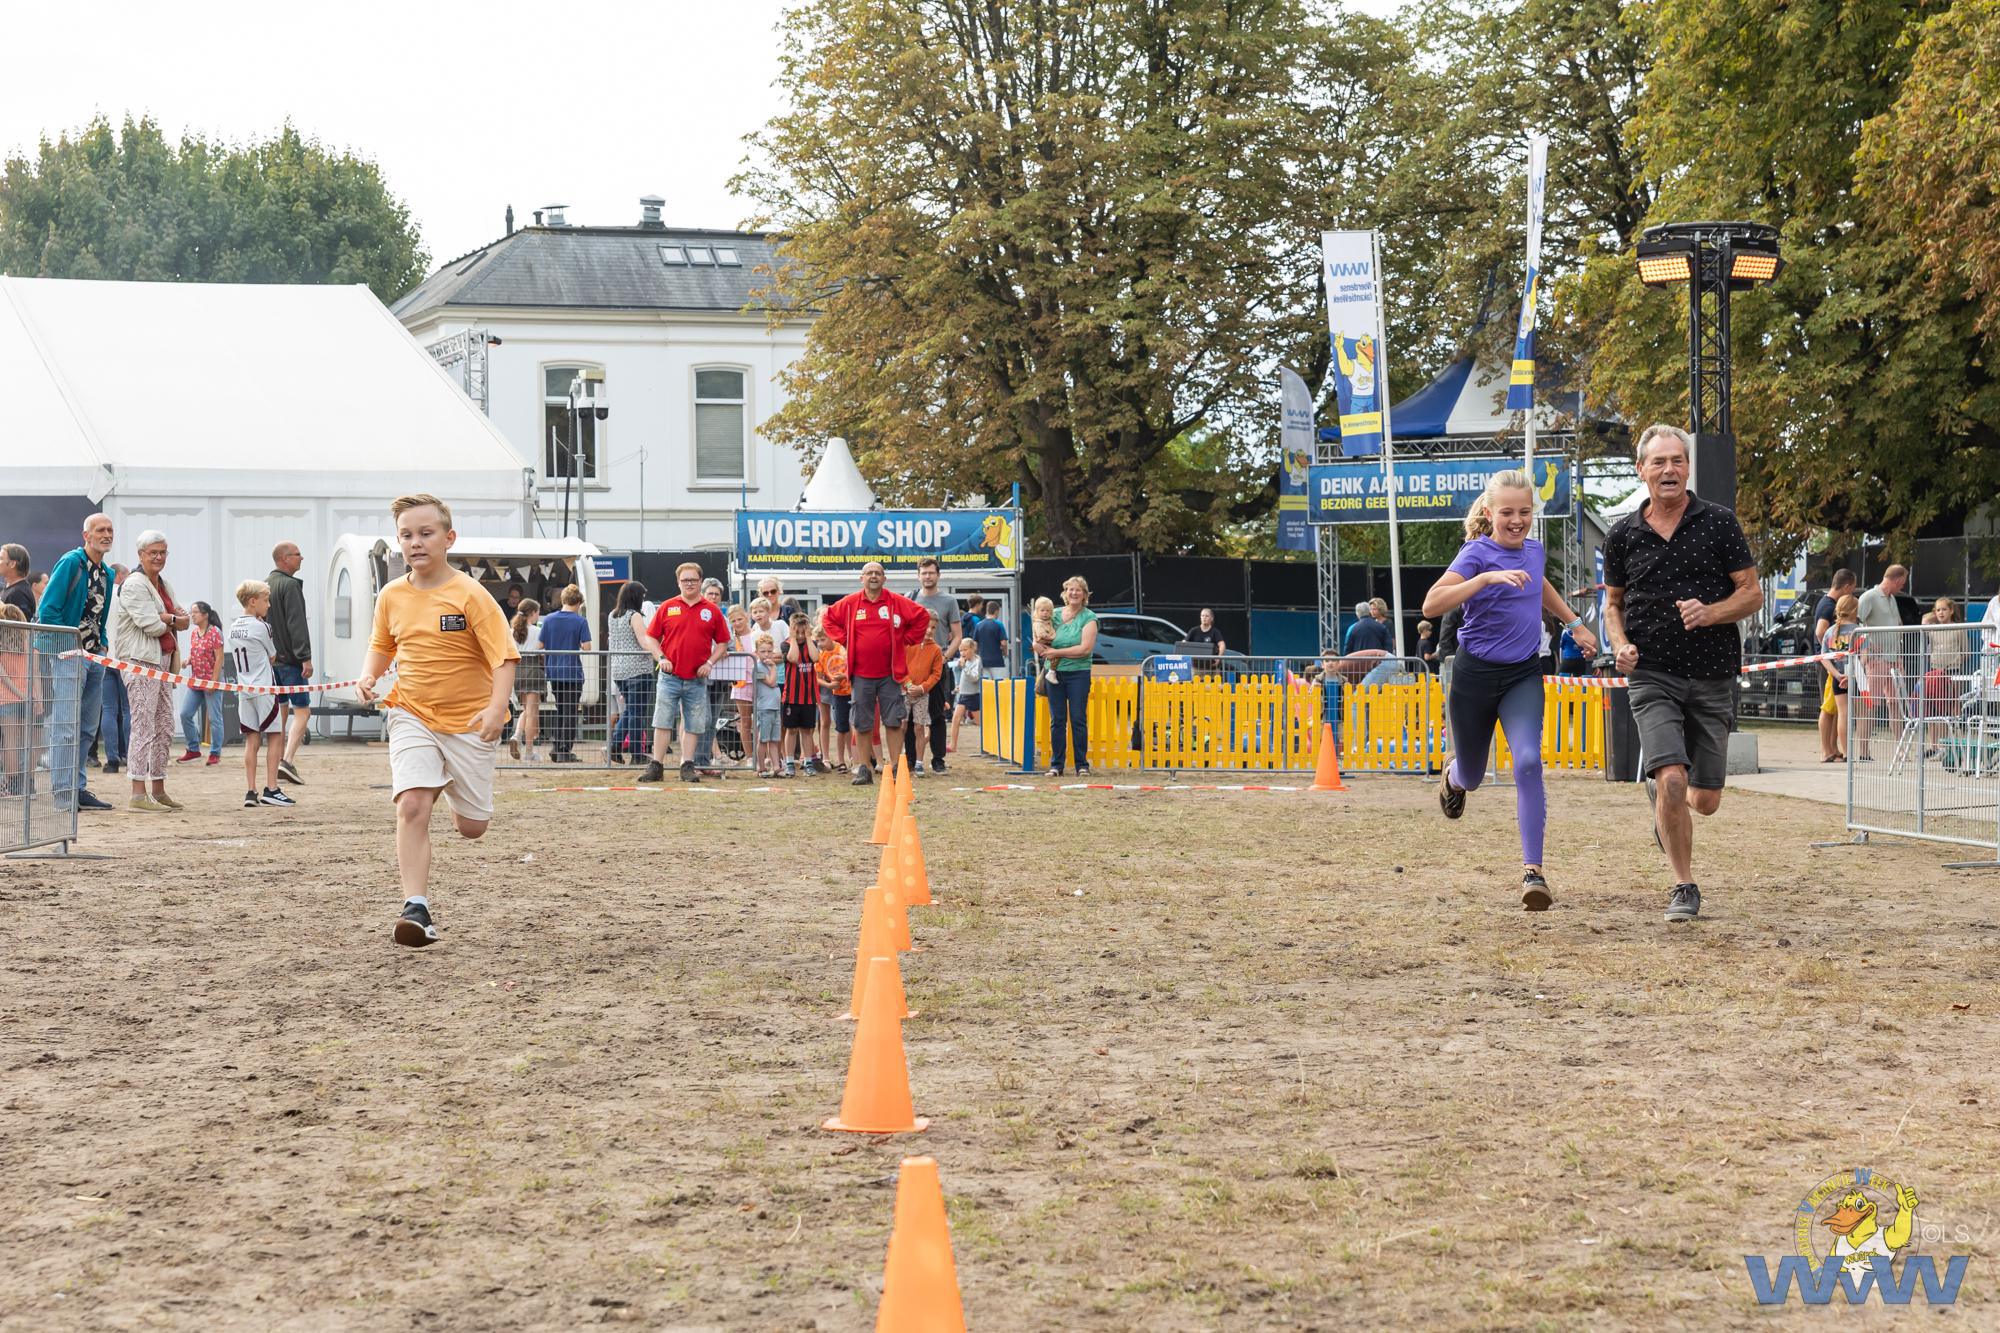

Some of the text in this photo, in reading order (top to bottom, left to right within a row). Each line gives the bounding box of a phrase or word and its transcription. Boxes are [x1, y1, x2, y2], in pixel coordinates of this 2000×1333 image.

[1320, 472, 1497, 495] DENK AAN DE BUREN
[1320, 498, 1362, 510] BEZORG
[1397, 494, 1453, 508] OVERLAST
[747, 519, 951, 548] WOERDY SHOP
[747, 554, 803, 563] KAARTVERKOOP
[807, 554, 844, 564] GEVONDEN
[845, 554, 892, 564] VOORWERPEN
[941, 553, 989, 563] MERCHANDISE
[234, 646, 250, 673] 11
[1157, 662, 1188, 671] UITGANG
